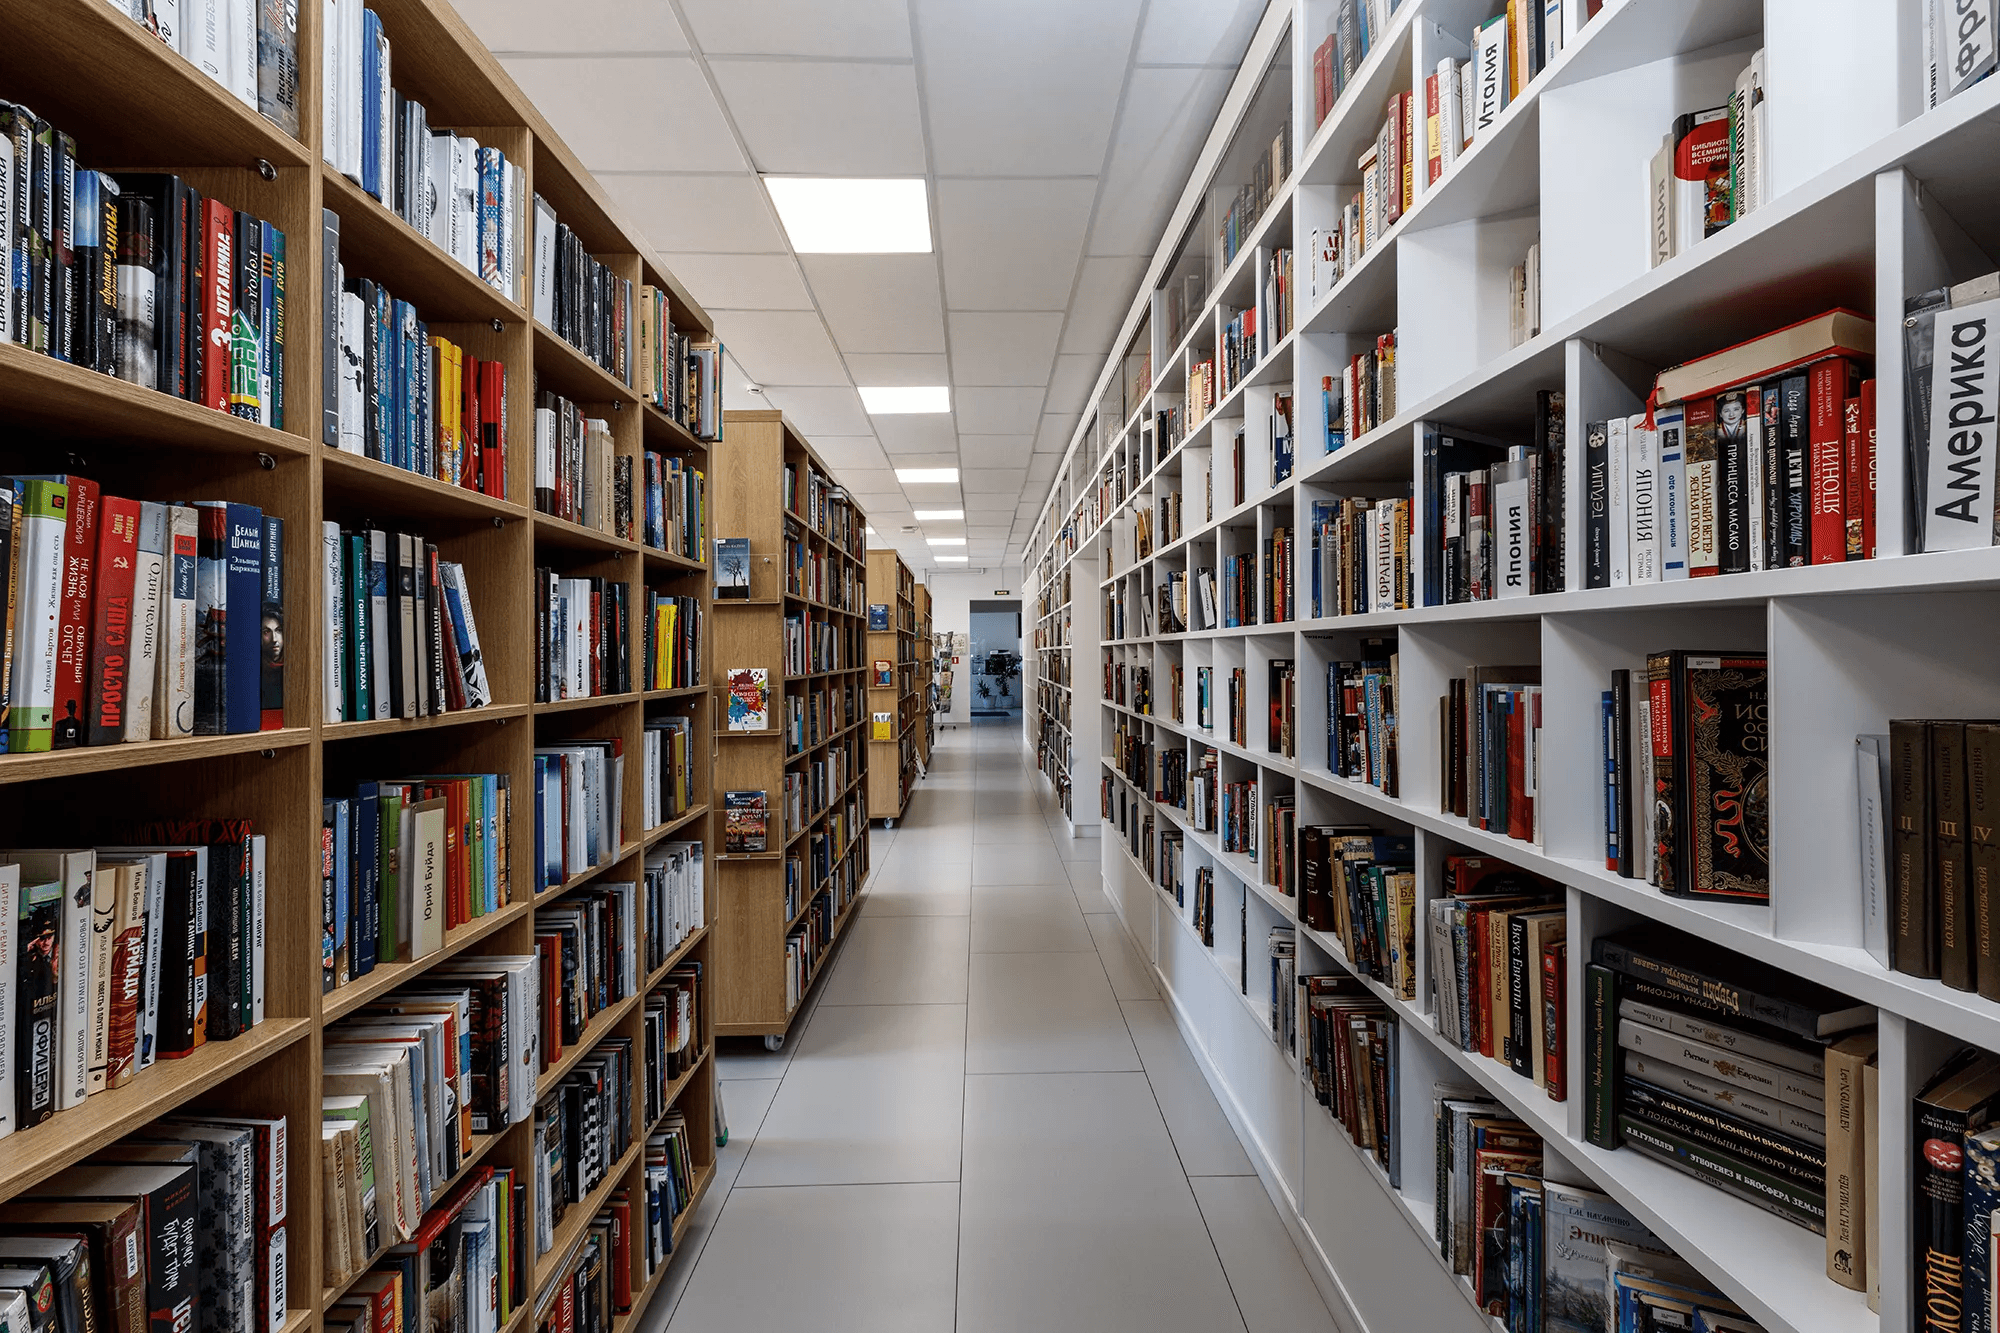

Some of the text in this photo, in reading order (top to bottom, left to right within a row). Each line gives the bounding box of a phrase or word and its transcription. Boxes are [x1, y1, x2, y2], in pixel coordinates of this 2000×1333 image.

[276, 47, 286, 105] Василий
[1478, 43, 1498, 131] Италия
[1380, 134, 1388, 218] Испания
[1691, 146, 1730, 158] ВСЕМИРН
[1691, 154, 1728, 165] ИСТОРИИ
[20, 237, 29, 346] ЧЕРНОБЫЛЬСКАЯ МОЛИТВА
[144, 290, 155, 323] рыба
[216, 232, 231, 317] ШТАНИНА
[1934, 317, 1995, 523] Америка
[1636, 468, 1653, 542] ЯПОНИЯ
[1701, 463, 1713, 552] ЗАПАДНЫЙ ВЕТЕР
[1727, 444, 1740, 551] ПРИНЦЕССА МАСАКО
[1786, 448, 1803, 546] ДЕТИ ХИРОСИМЫ
[1812, 442, 1820, 515] КРАТКАЯ ИСТОРИЯ
[1822, 439, 1840, 515] ЯПОНИИ
[1506, 505, 1521, 587] Япония
[1689, 475, 1701, 553] ЯСНАЯ ПОГОДА
[1379, 521, 1392, 598] ФРАНЦИЯ
[47, 582, 58, 609] Жизнь
[0, 661, 11, 708] Александр
[43, 628, 54, 695] Аркадий Бартов
[100, 596, 128, 727] ПРОСТО САША
[358, 641, 366, 690] ЧЕРЕПАХАХ
[1654, 694, 1662, 742] ИСТОРИЯ
[1660, 681, 1668, 713] СИБИРИ
[1939, 820, 1957, 837] III
[1973, 826, 1992, 841] IV
[132, 871, 142, 921] Илья Бояшов
[196, 878, 205, 898] Илья
[424, 841, 435, 921] Юрий Буйда
[0, 883, 9, 966] ДИТРИХ РЕМАРК
[196, 899, 205, 931] Бояшов
[123, 937, 141, 1000] АРМАДА
[1511, 923, 1522, 1010] ВКУС ЕВРОПЫ
[1633, 958, 1700, 986] культуры славян
[1636, 983, 1720, 1011] СТРУНА ИСТОРИИ
[1666, 977, 1740, 1013] Очерки истории
[33, 1019, 51, 1107] ОФИЦЕРЫ
[359, 1118, 372, 1176] МАХНО
[1646, 1110, 1692, 1133] ПОИСКАХ
[1693, 1127, 1786, 1170] ВЫМЫШЛЕННОГО
[1788, 1165, 1826, 1186] ЦАРСТ
[1677, 1105, 1716, 1126] ГУМИЛЕВ
[1720, 1121, 1752, 1140] КОНЕЦ
[1761, 1137, 1795, 1156] ВНОВЬ
[1795, 1149, 1827, 1167] НАЧАЛ
[242, 1147, 252, 1235] СВОИМИ ГЛАЗАМИ
[1689, 1153, 1734, 1179] ЭТНОГЕНЕЗ
[1743, 1175, 1791, 1204] БИОСФЕРА
[1791, 1197, 1825, 1218] ЗЕМЛИ
